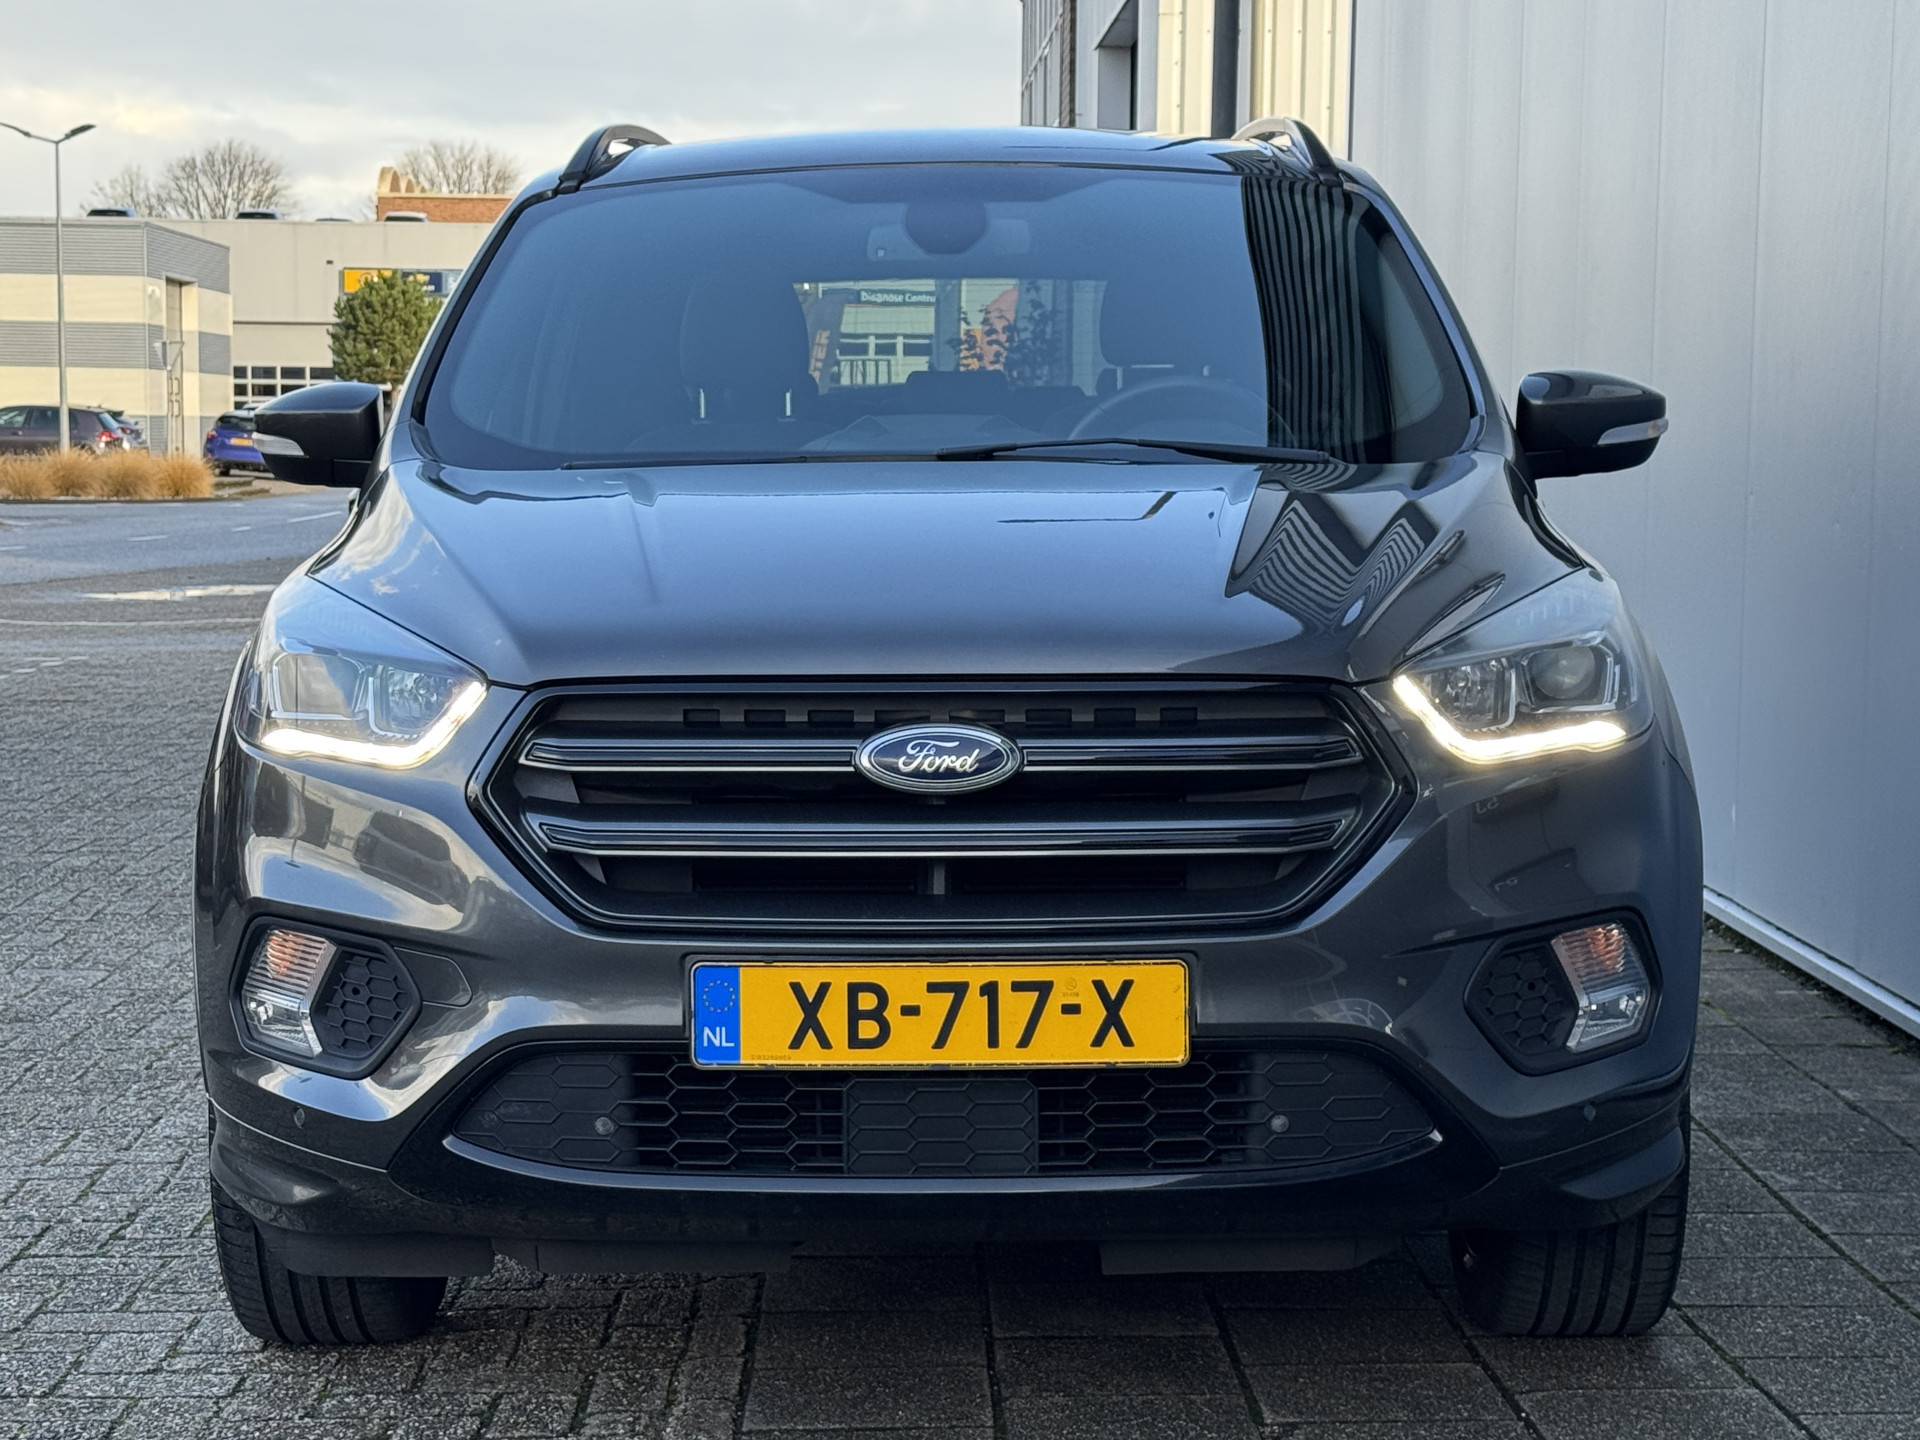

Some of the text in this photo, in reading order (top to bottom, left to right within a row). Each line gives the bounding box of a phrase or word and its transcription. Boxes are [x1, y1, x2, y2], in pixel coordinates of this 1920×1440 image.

[861, 290, 904, 303] Diagnose
[898, 739, 980, 773] Ford
[788, 979, 1135, 1050] XB-717-X
[703, 1026, 735, 1048] NL
